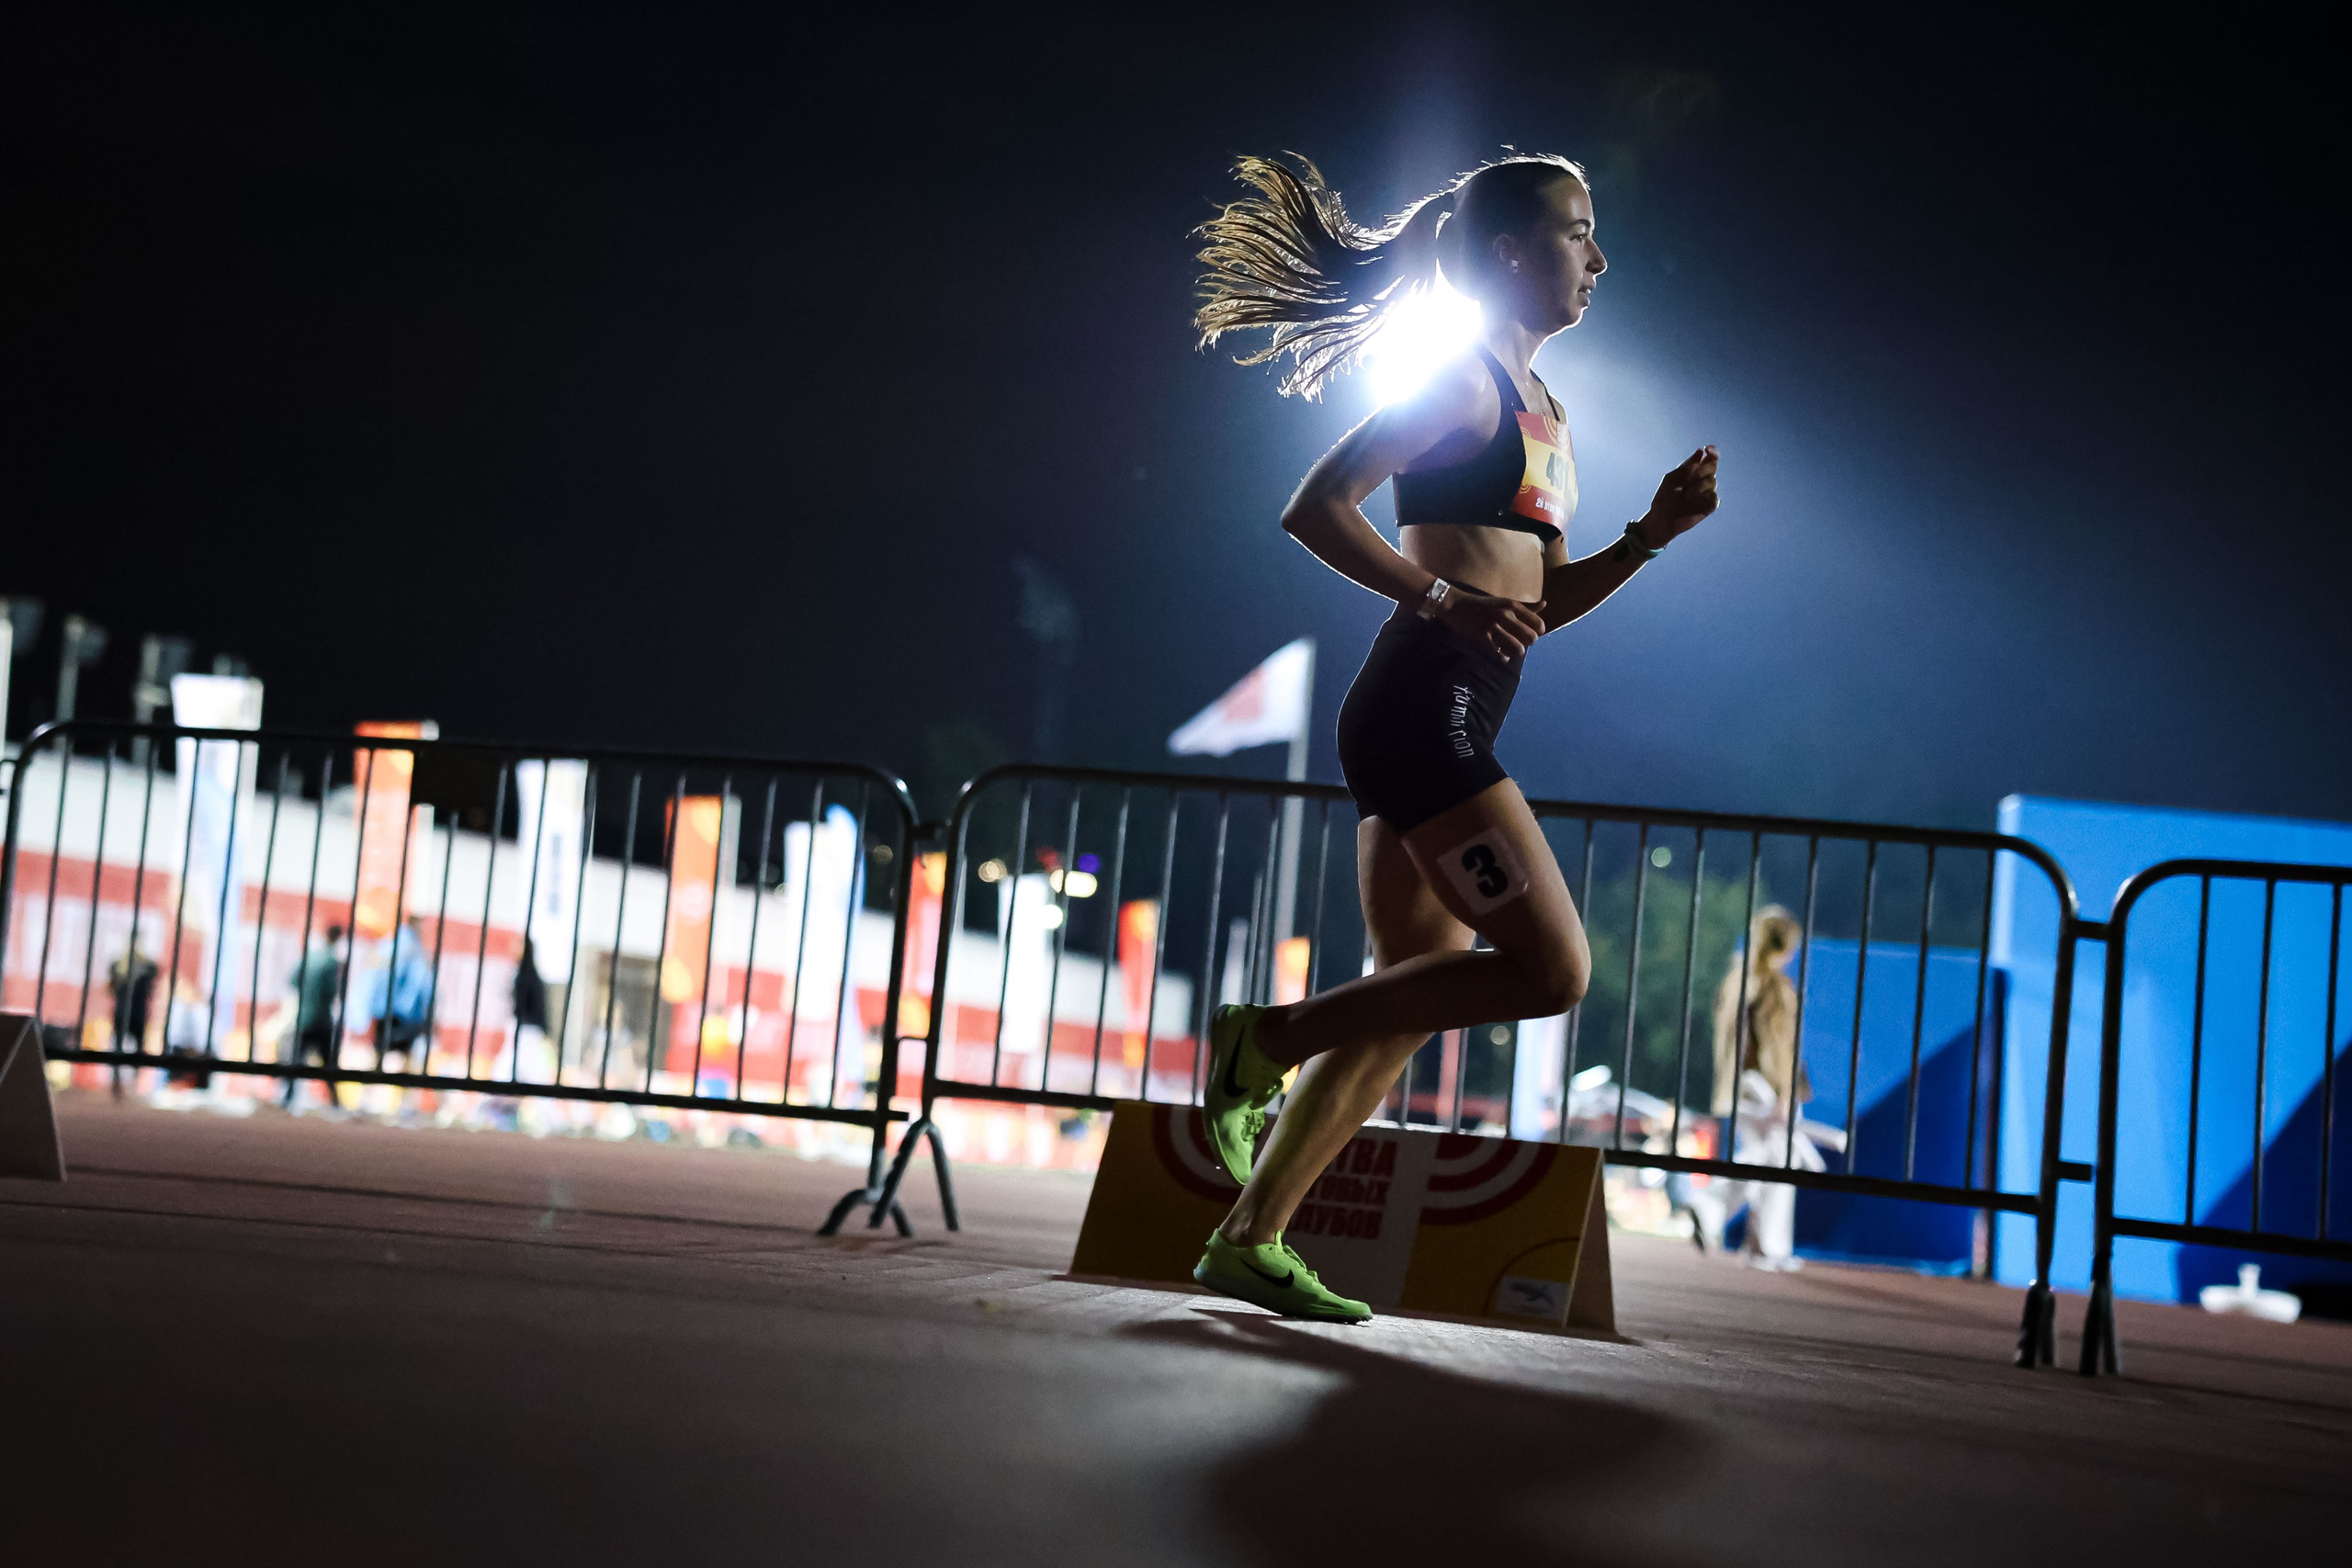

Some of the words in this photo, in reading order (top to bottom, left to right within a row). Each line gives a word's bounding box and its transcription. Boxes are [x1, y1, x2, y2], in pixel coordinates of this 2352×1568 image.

[1462, 843, 1509, 898] 3
[1337, 1138, 1396, 1177] ТВА
[1287, 1203, 1384, 1239] ЛУБОВ
